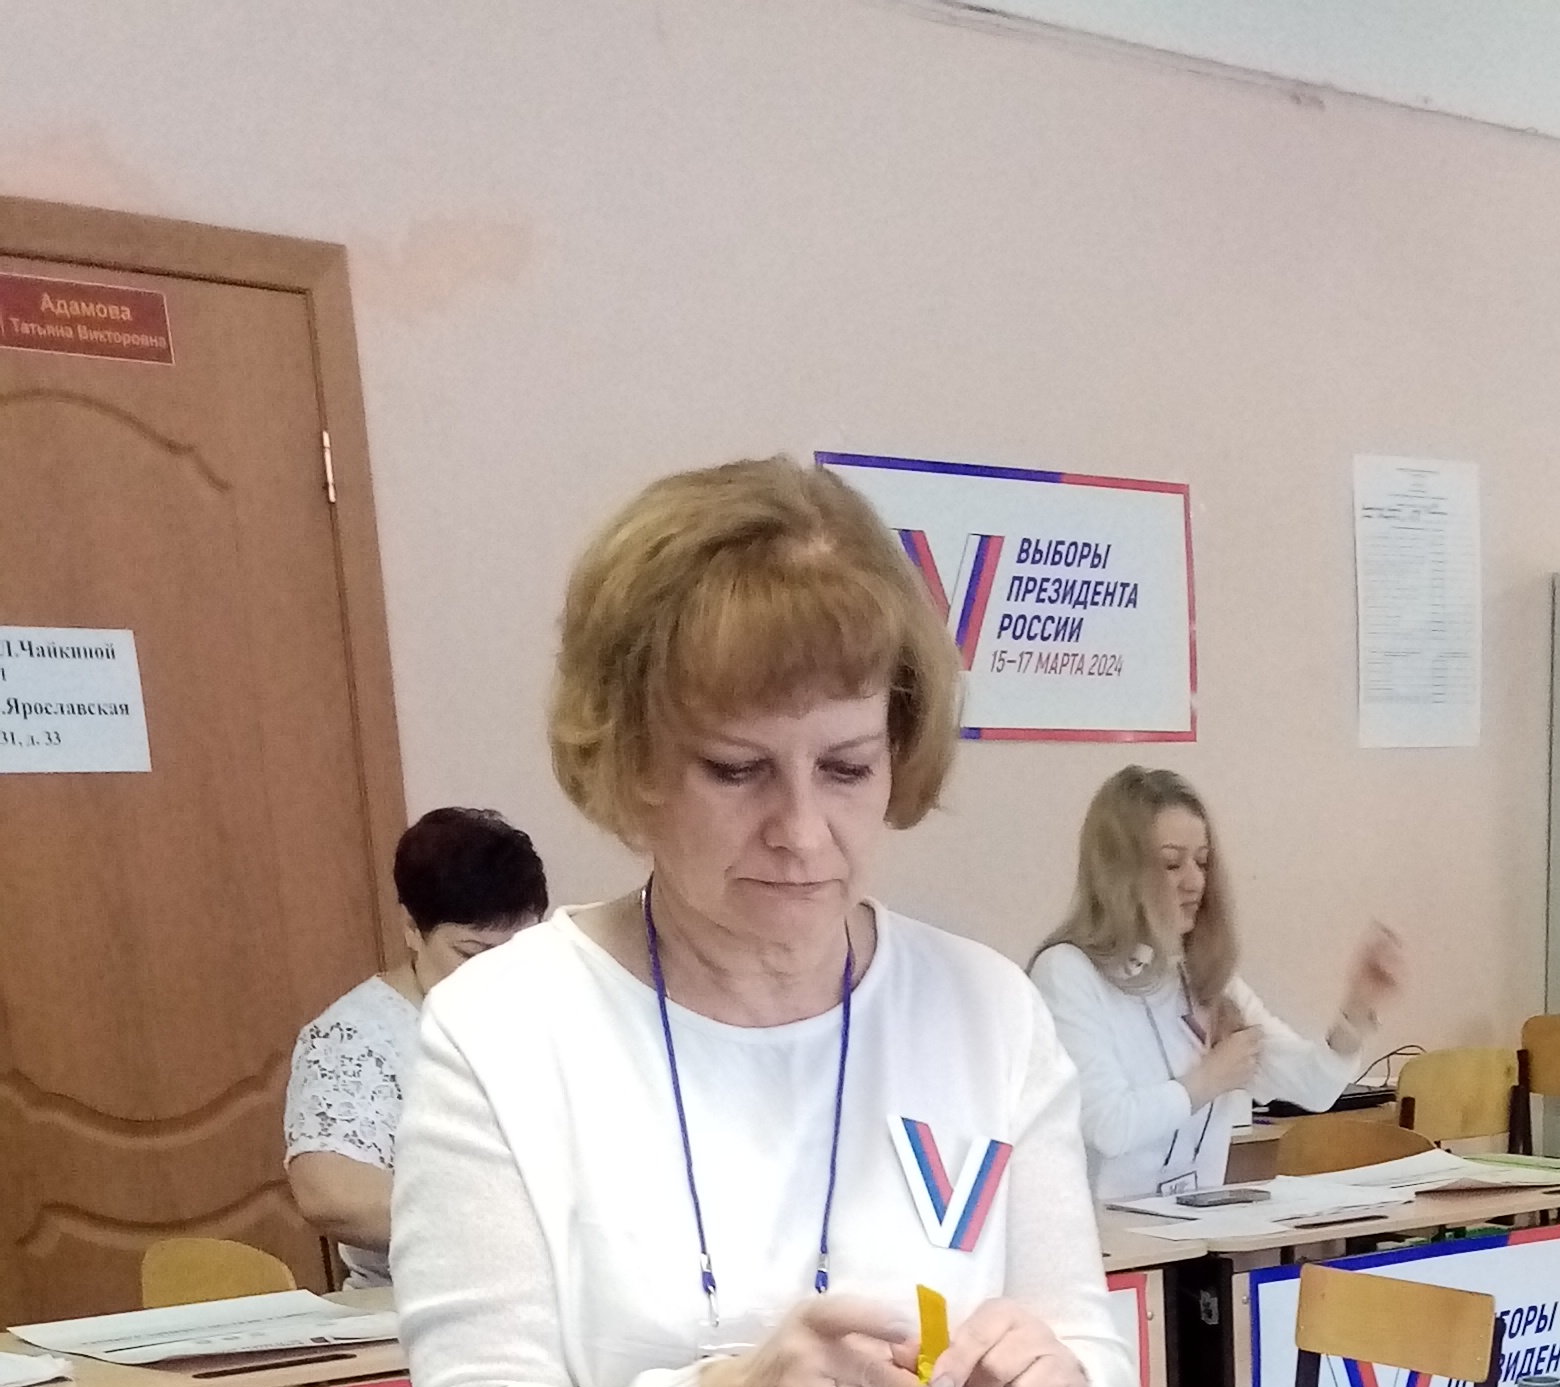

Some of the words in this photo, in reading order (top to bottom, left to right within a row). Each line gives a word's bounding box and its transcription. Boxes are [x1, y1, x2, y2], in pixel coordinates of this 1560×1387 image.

[41, 292, 133, 321] Адамова
[9, 317, 74, 340] Татьяна
[77, 324, 168, 348] Викторовна
[1016, 537, 1112, 569] ВЫБОРЫ
[1006, 575, 1138, 610] ПРЕЗИДЕНТА
[997, 613, 1084, 643] РОССИИ
[1034, 652, 1086, 676] МАРТА
[1087, 653, 1124, 677] 2024
[44, 731, 62, 746] 33
[1500, 1301, 1559, 1340] ОРЫ
